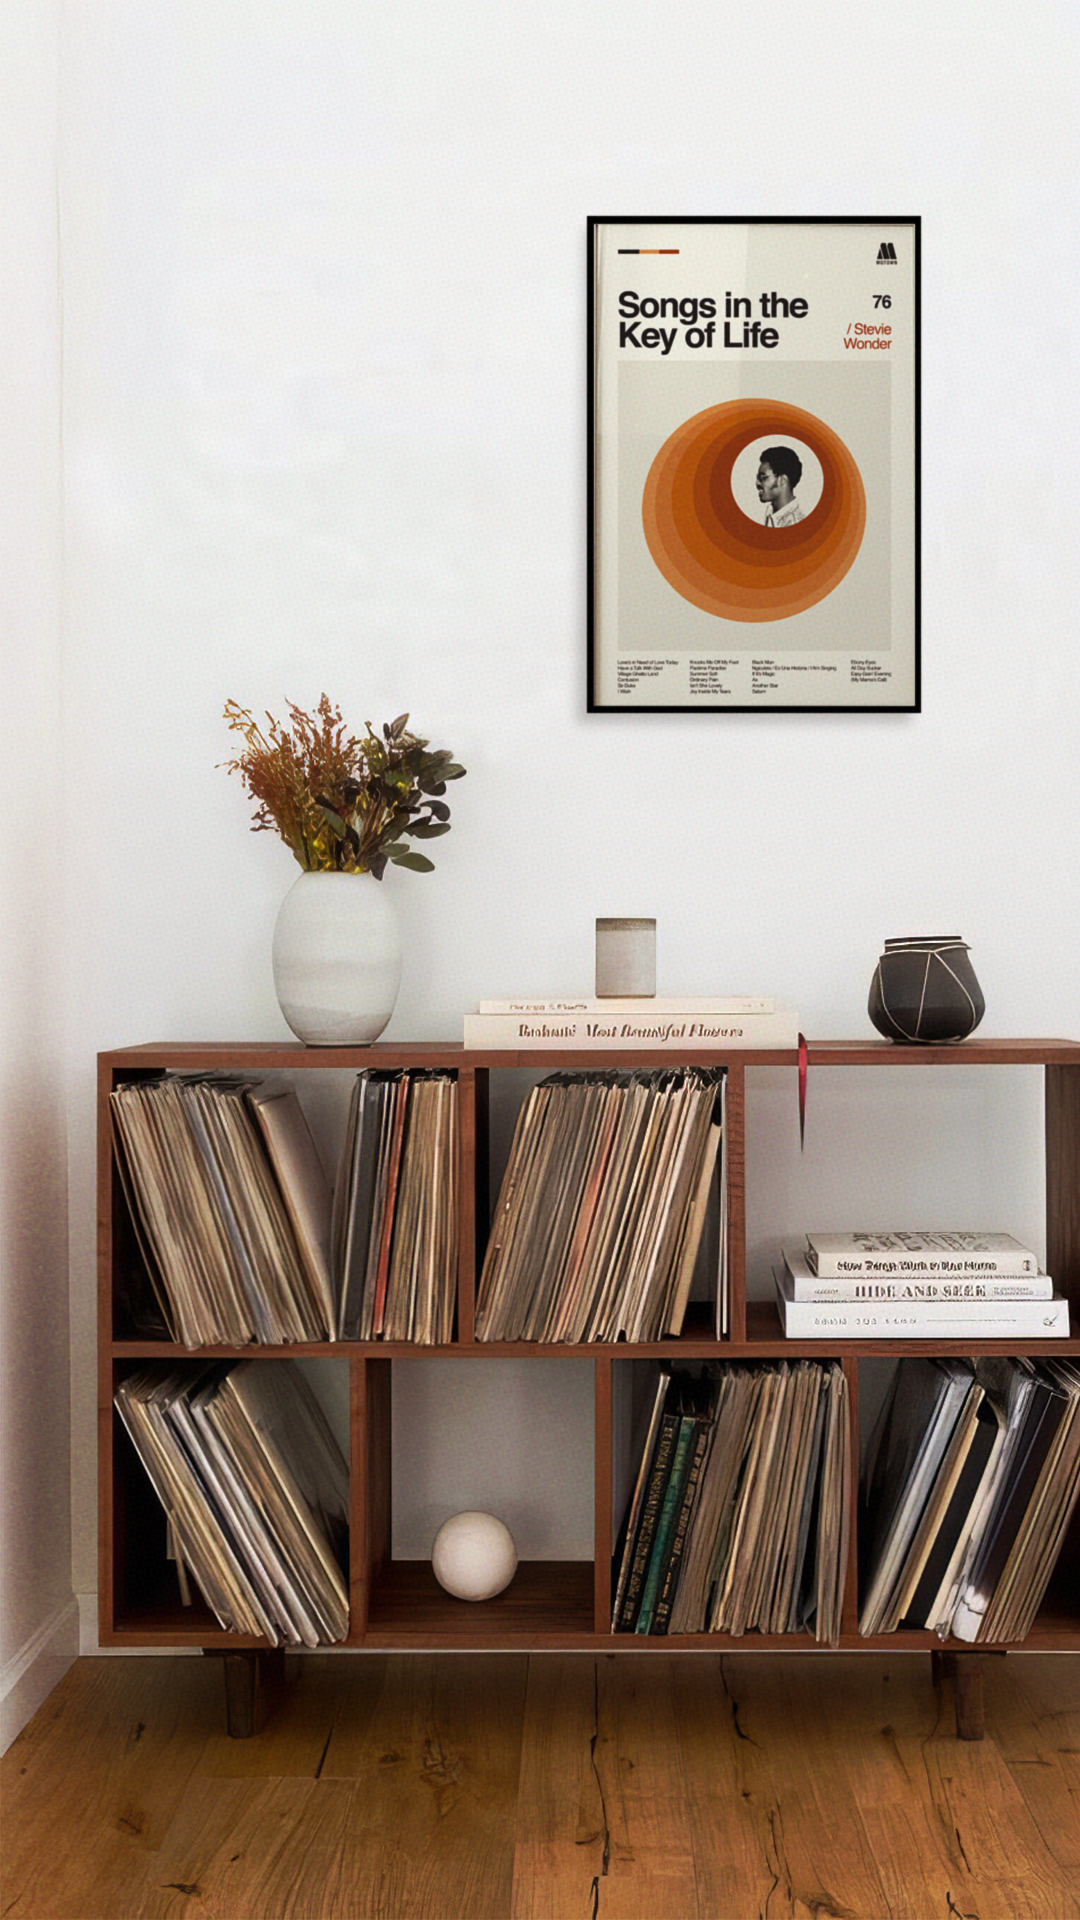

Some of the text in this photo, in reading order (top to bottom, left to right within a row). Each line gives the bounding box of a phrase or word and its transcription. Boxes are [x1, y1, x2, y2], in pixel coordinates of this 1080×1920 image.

[618, 290, 808, 325] Songs in the
[872, 295, 892, 309] 76
[846, 323, 892, 335] / Stevie
[619, 322, 779, 355] Key of Life
[844, 338, 892, 350] Wonder
